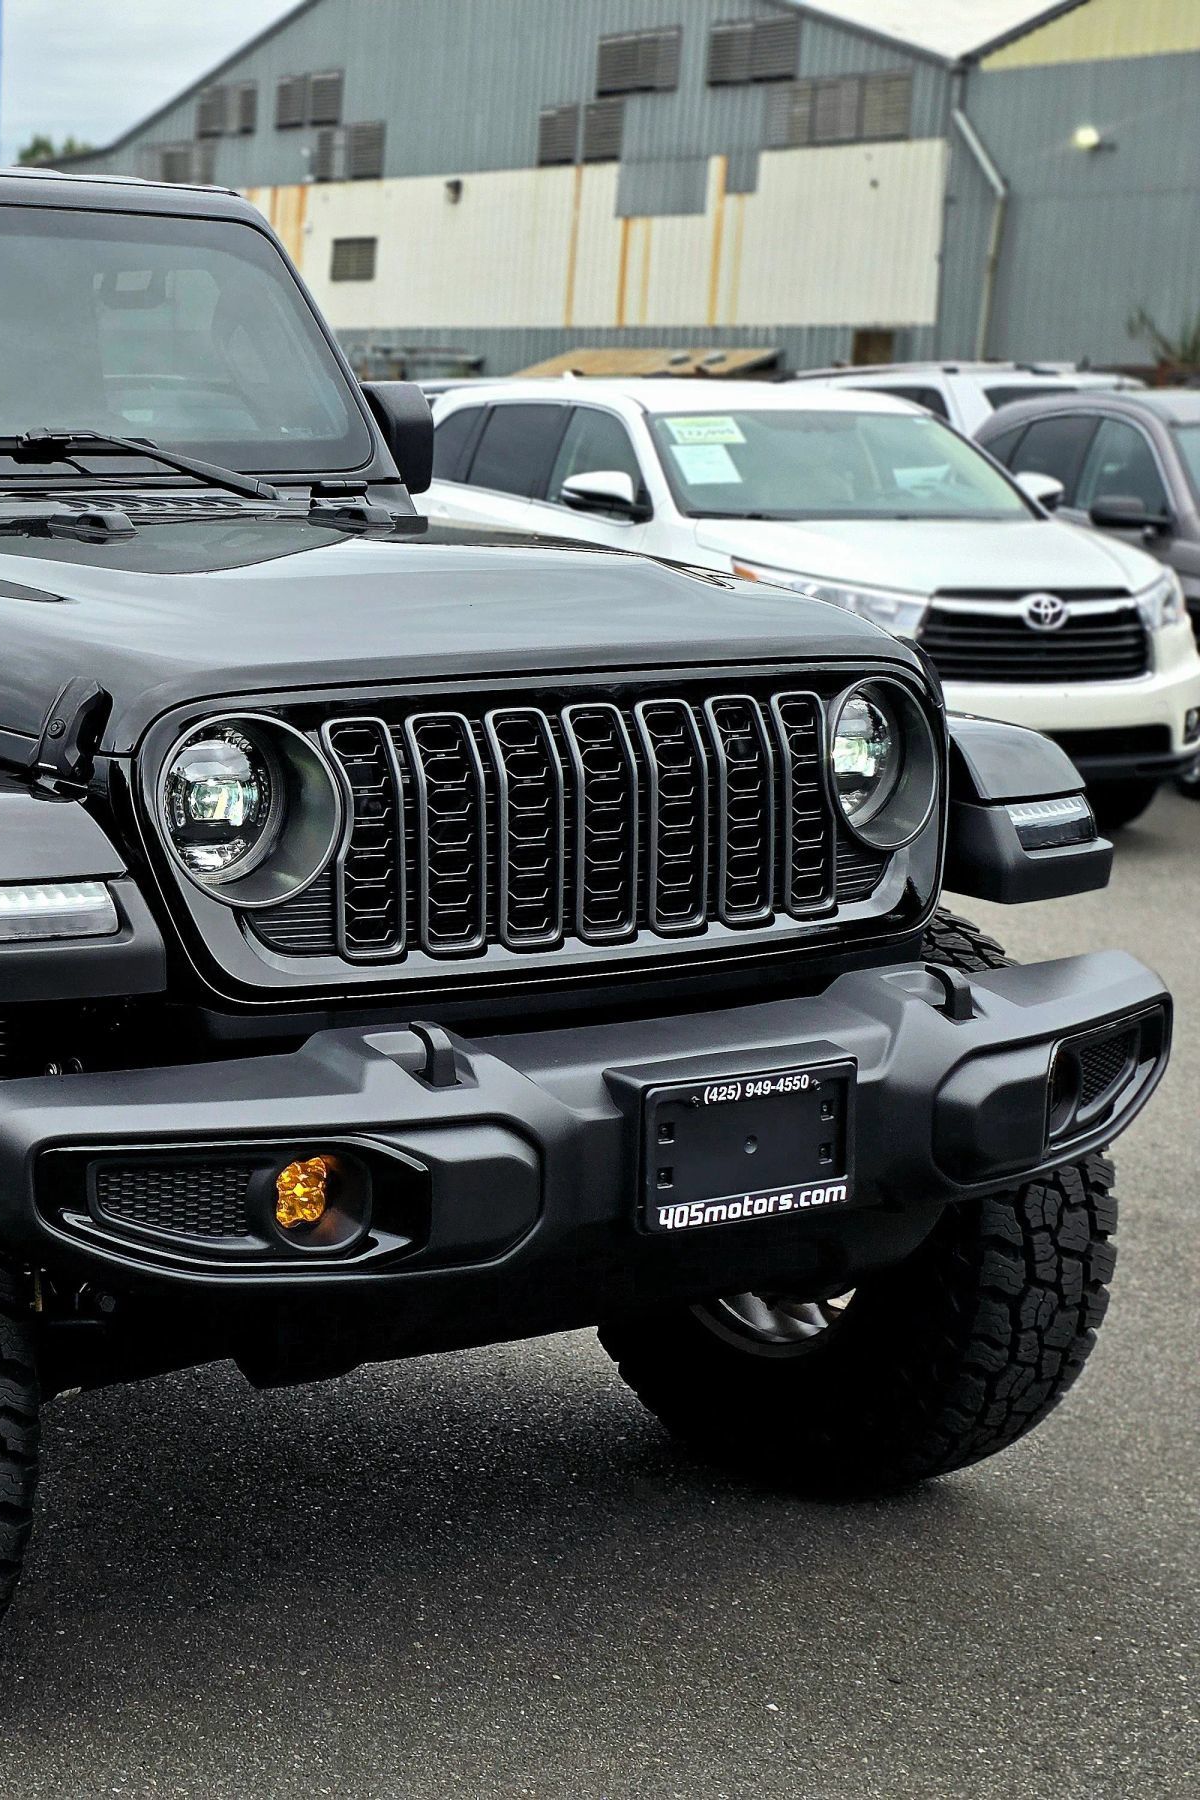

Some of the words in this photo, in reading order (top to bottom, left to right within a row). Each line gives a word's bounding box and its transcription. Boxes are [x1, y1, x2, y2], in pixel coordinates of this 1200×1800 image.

[703, 1085, 741, 1104] (425)
[745, 1075, 809, 1098] 949-4550
[659, 1185, 847, 1229] 405motors.com
